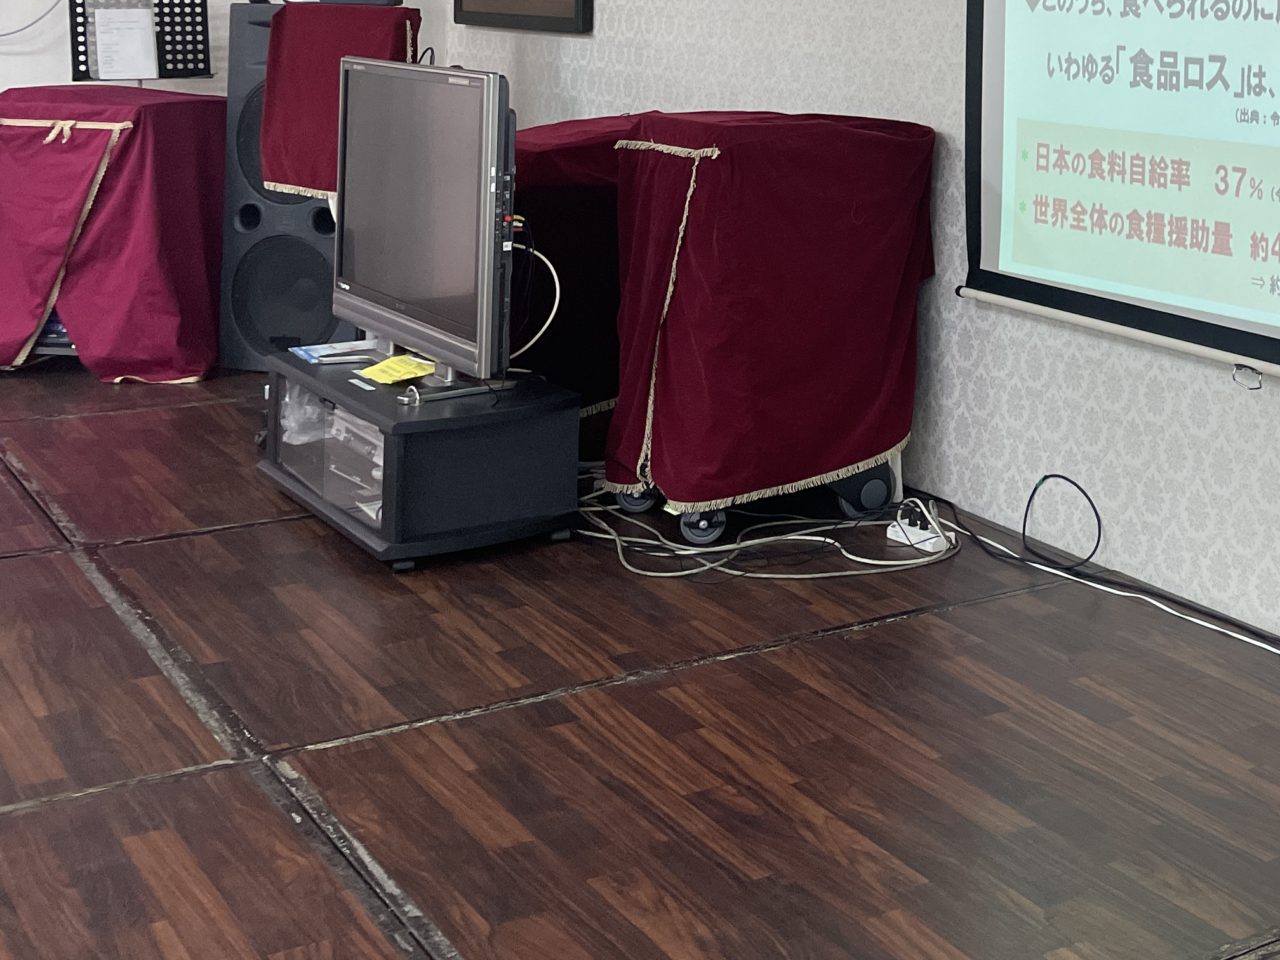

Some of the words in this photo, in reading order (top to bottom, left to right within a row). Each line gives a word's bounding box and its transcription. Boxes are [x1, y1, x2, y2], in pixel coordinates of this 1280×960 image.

[1035, 142, 1192, 192] 日本の食料自給率
[1032, 193, 1234, 258] 世界全体の食糧援助量
